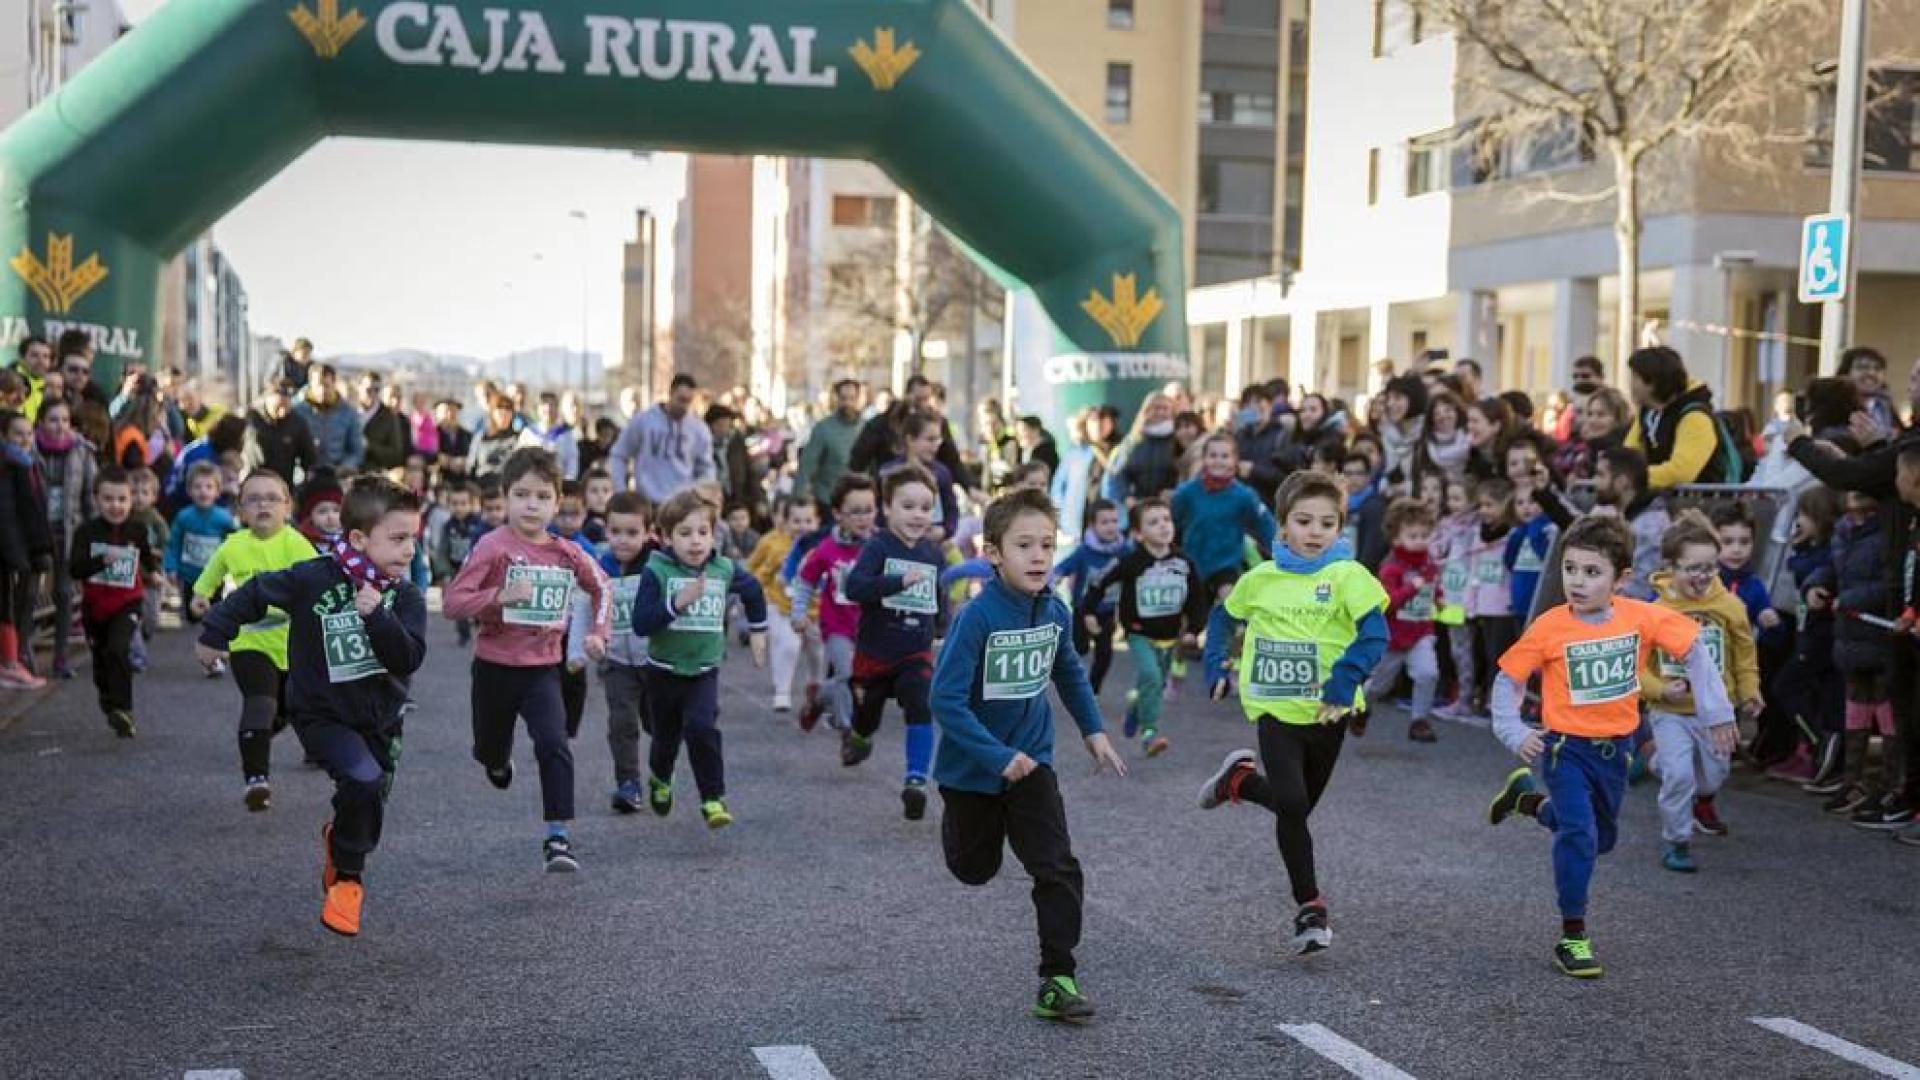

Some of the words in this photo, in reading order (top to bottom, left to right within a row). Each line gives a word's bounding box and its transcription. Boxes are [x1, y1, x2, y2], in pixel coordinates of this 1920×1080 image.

[375, 1, 566, 75] CAJA
[584, 14, 837, 88] RURAL
[518, 586, 565, 608] 168
[331, 633, 374, 662] 13
[994, 646, 1052, 680] 1104
[1256, 656, 1313, 683] 1089
[1574, 653, 1634, 688] 1042
